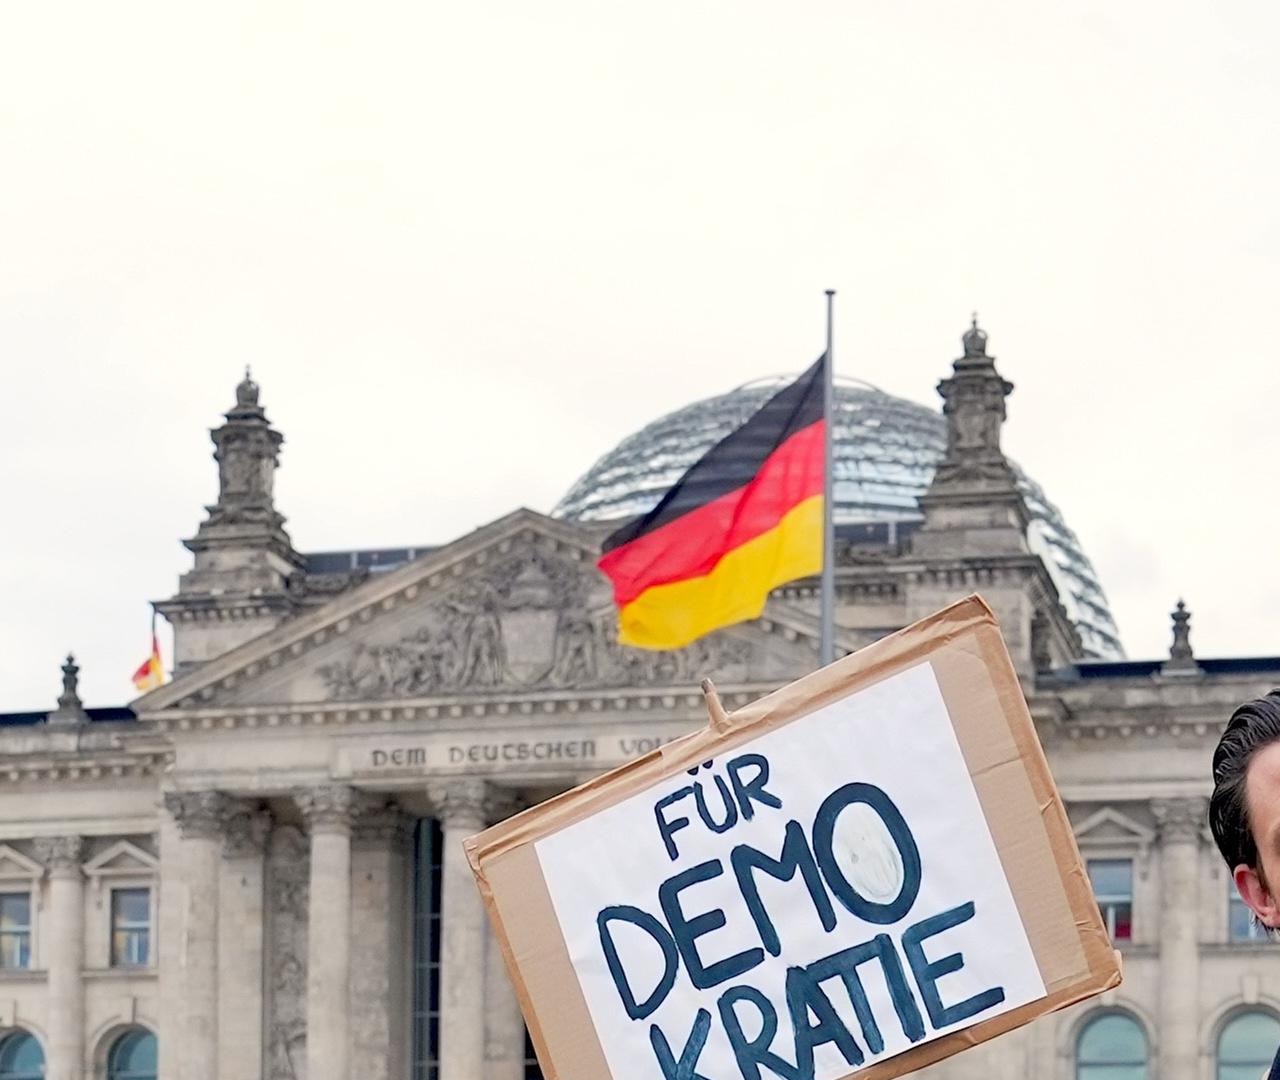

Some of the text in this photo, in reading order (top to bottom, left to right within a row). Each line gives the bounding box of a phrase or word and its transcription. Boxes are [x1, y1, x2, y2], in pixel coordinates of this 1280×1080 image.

[371, 747, 427, 767] DEM
[448, 738, 597, 763] DEUTSCHEN
[653, 753, 783, 862] FÜR
[596, 781, 922, 1022] DEMO
